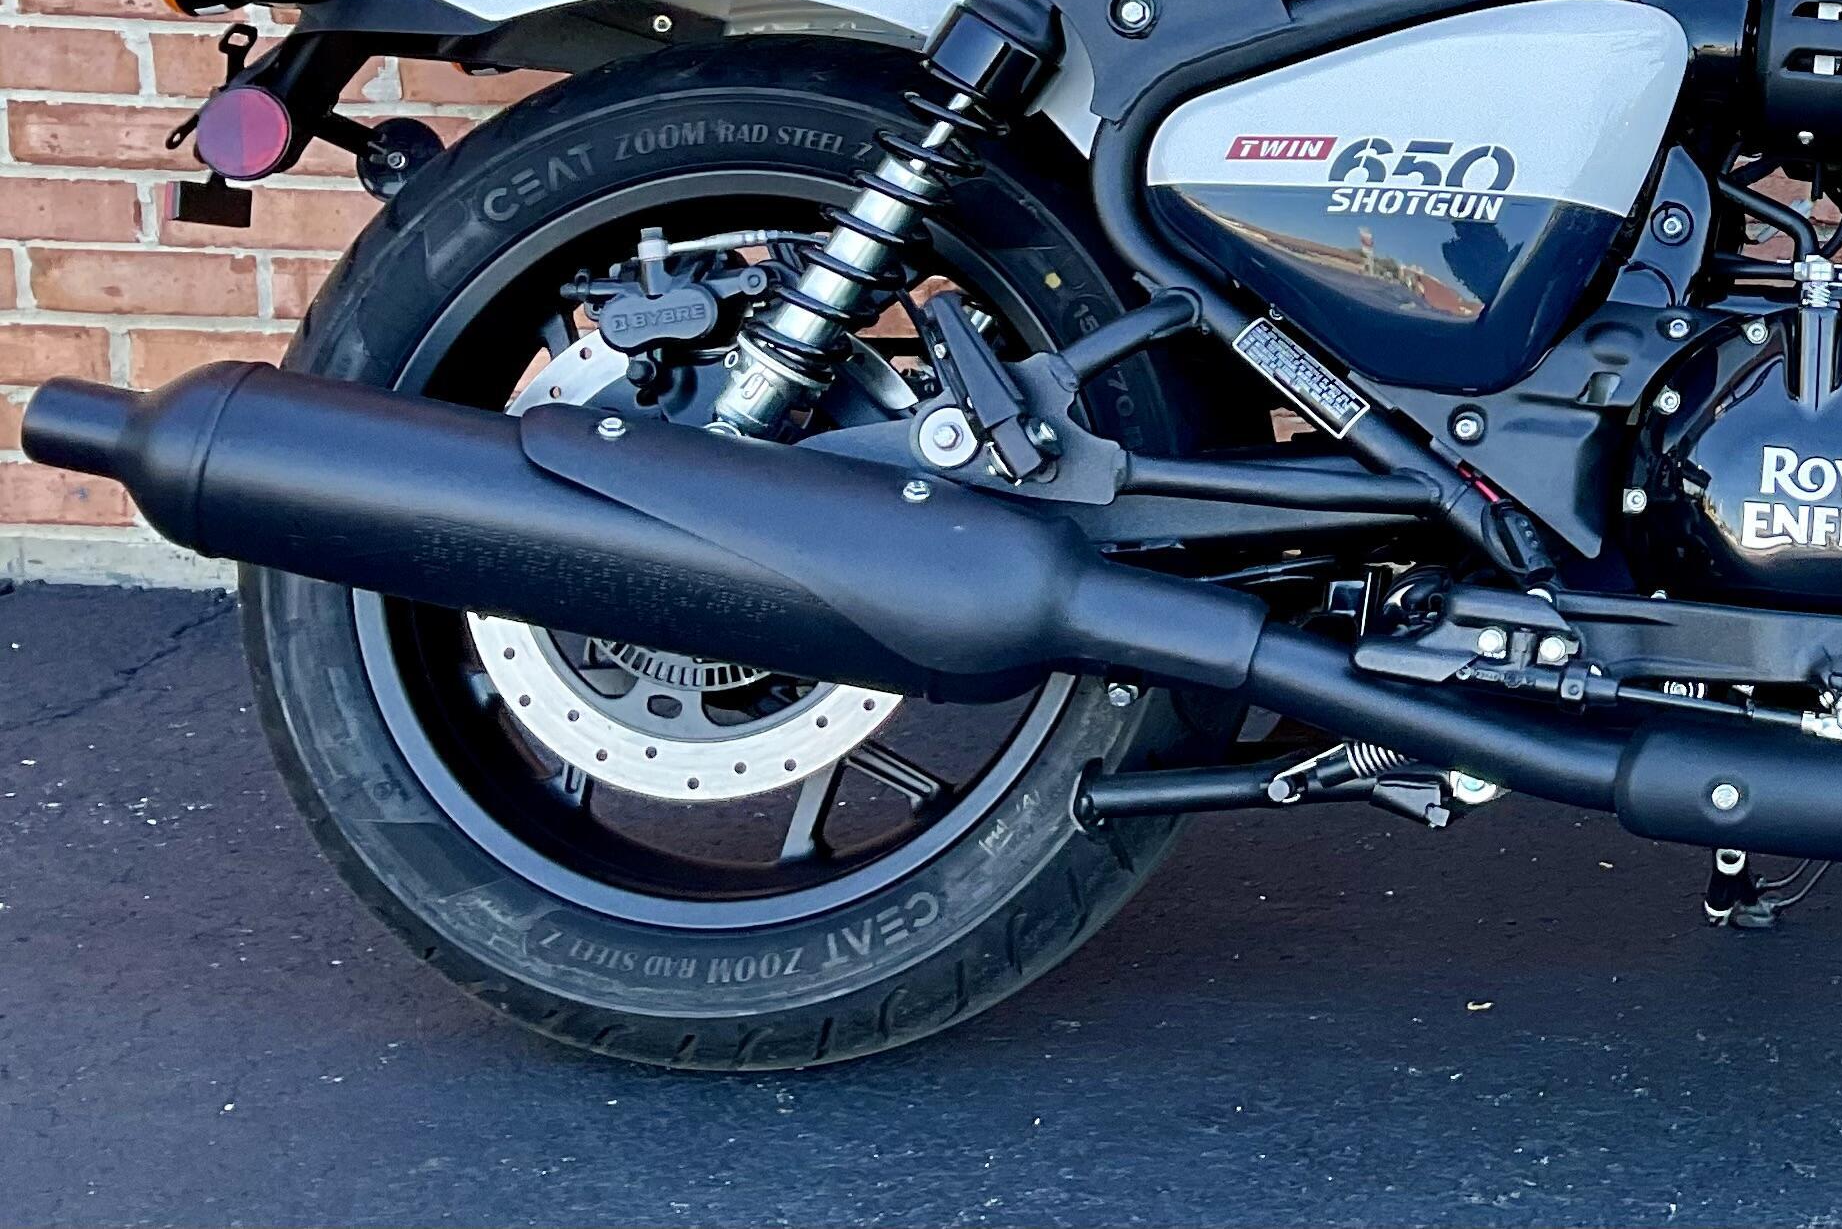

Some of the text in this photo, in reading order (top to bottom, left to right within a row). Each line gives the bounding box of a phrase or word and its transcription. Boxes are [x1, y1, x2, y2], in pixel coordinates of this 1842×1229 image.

[1239, 139, 1325, 158] TWIN
[1327, 137, 1516, 191] 650
[483, 142, 594, 221] CEAT
[613, 120, 707, 162] ZOOM
[716, 122, 770, 145] RAD
[775, 125, 845, 156] STEEL
[1327, 187, 1504, 221] SHOTGUN
[631, 303, 705, 328] BYBRE
[821, 891, 940, 969] CEAT
[568, 937, 639, 972] STEEL
[643, 954, 697, 979] RAD
[706, 946, 805, 984] ZOOM
